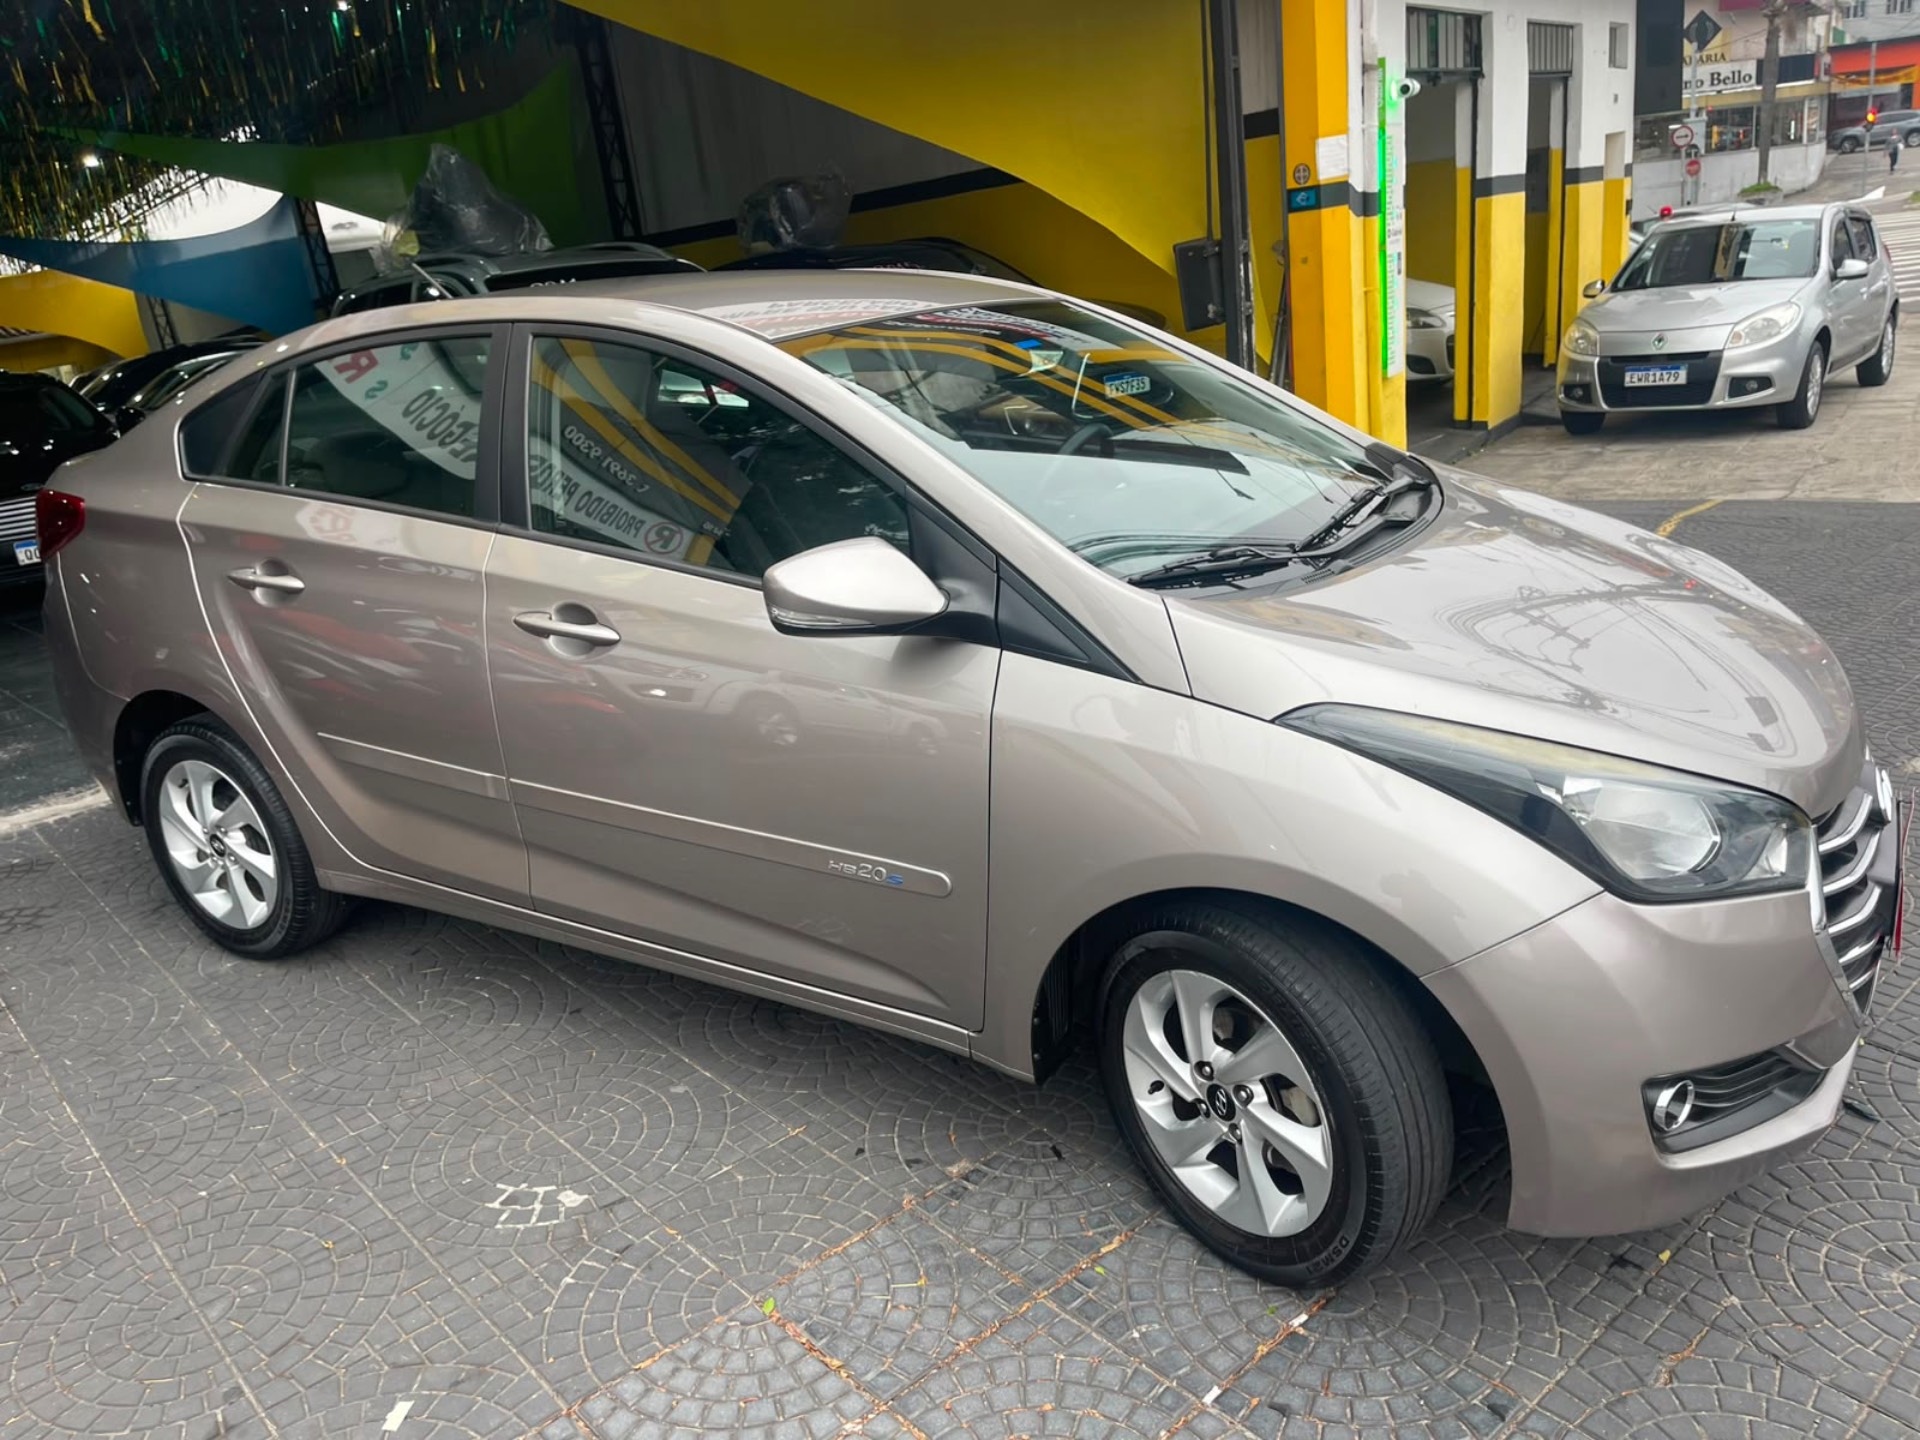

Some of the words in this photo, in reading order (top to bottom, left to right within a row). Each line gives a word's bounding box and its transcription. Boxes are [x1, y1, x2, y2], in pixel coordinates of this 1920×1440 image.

[1709, 69, 1753, 87] Bello
[1629, 371, 1680, 384] EWR1A79
[828, 860, 904, 886] HB20S
